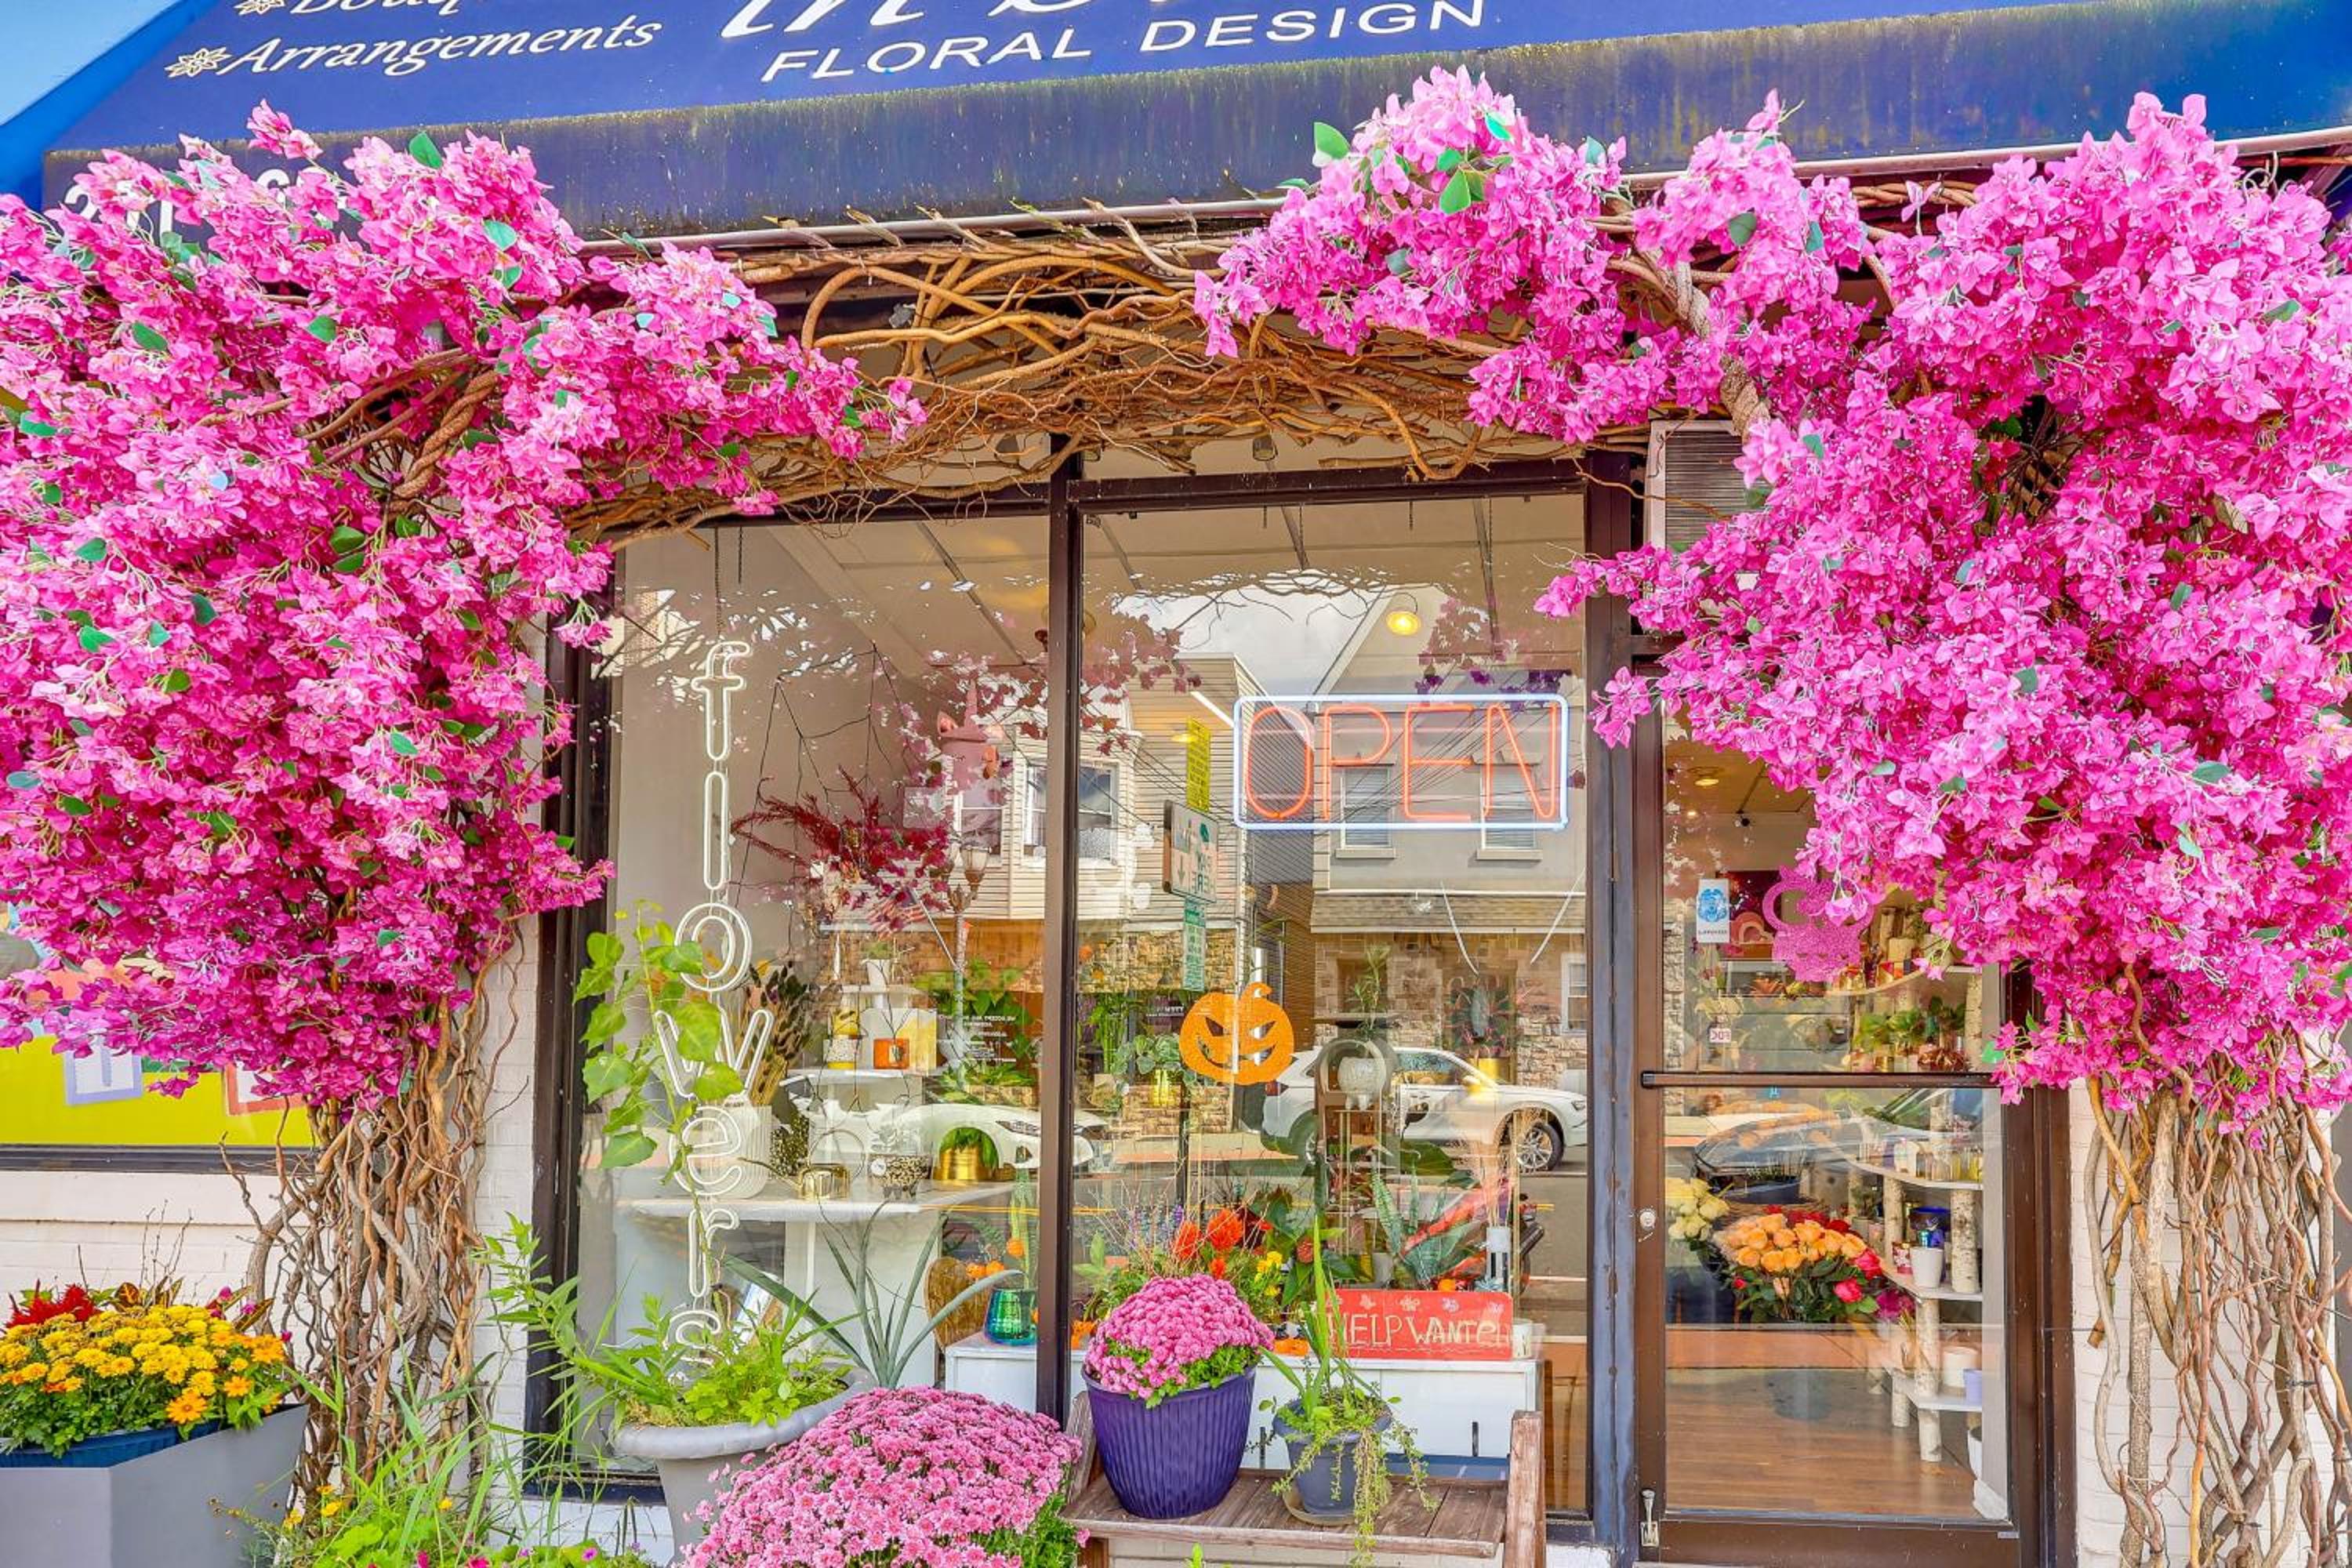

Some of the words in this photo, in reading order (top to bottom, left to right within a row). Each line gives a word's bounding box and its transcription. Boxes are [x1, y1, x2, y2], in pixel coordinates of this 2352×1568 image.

[216, 14, 662, 77] Arrangements
[760, 26, 1092, 82] FLORAL
[1139, 0, 1486, 52] DESIGN
[1244, 703, 1558, 821] OPEN
[1327, 1312, 1403, 1347] HELP
